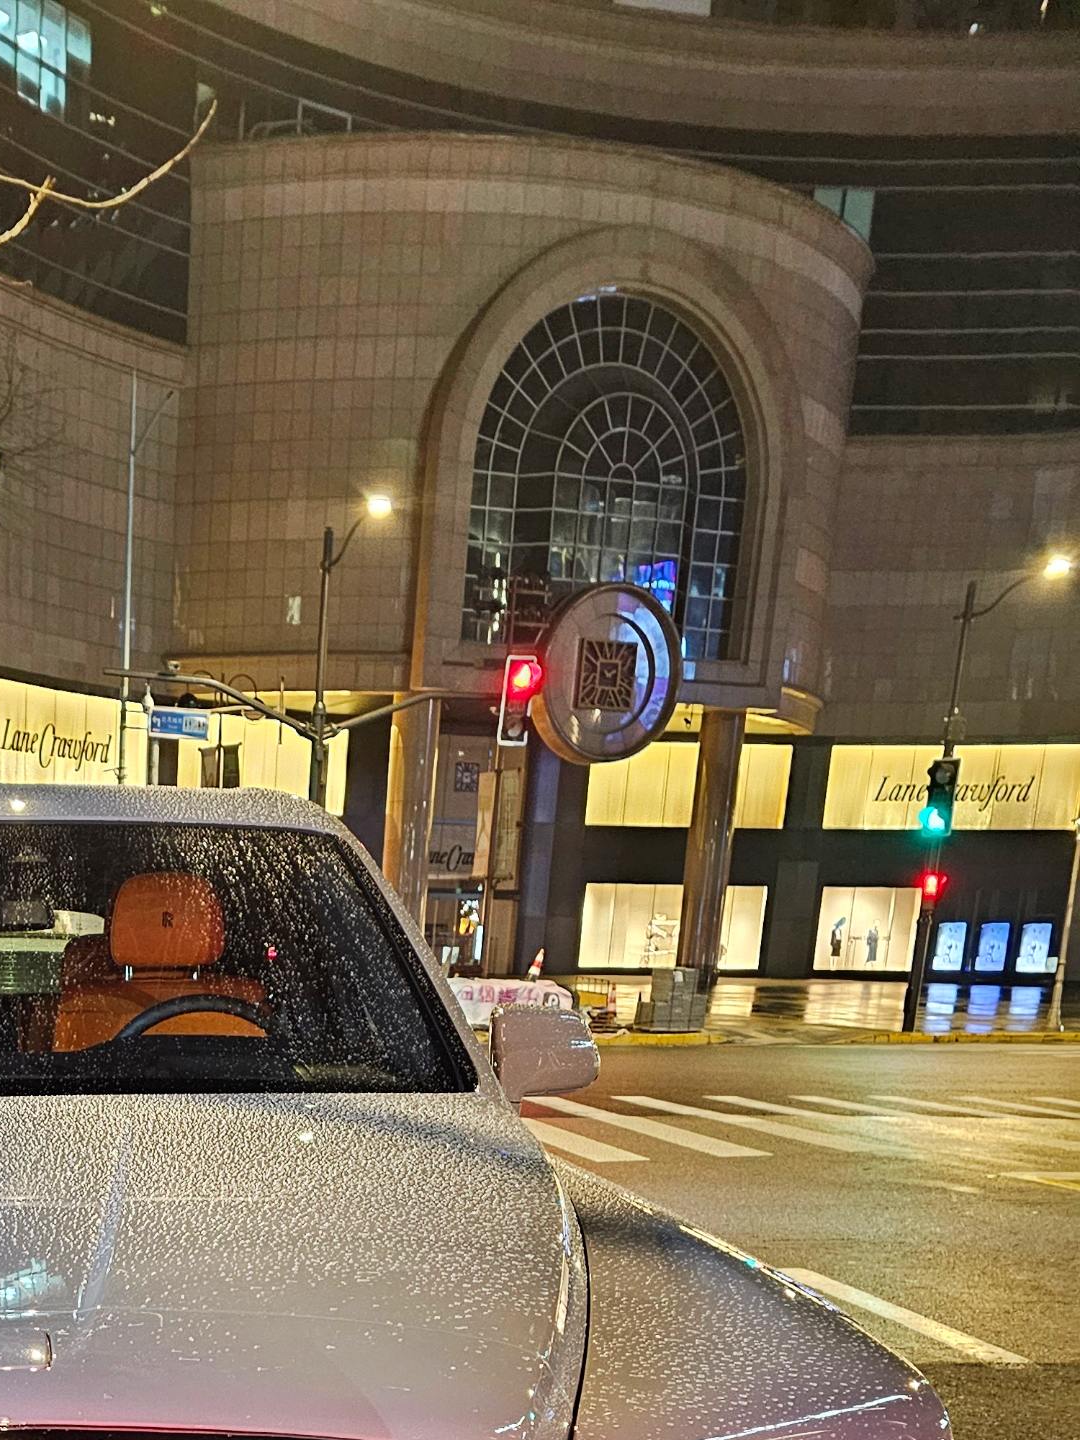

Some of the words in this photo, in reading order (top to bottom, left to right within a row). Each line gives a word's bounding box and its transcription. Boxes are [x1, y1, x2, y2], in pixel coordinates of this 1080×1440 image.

[0, 718, 39, 755] Lane
[38, 722, 113, 773] Crawford
[874, 775, 929, 803] Lane
[953, 775, 1036, 813] awford
